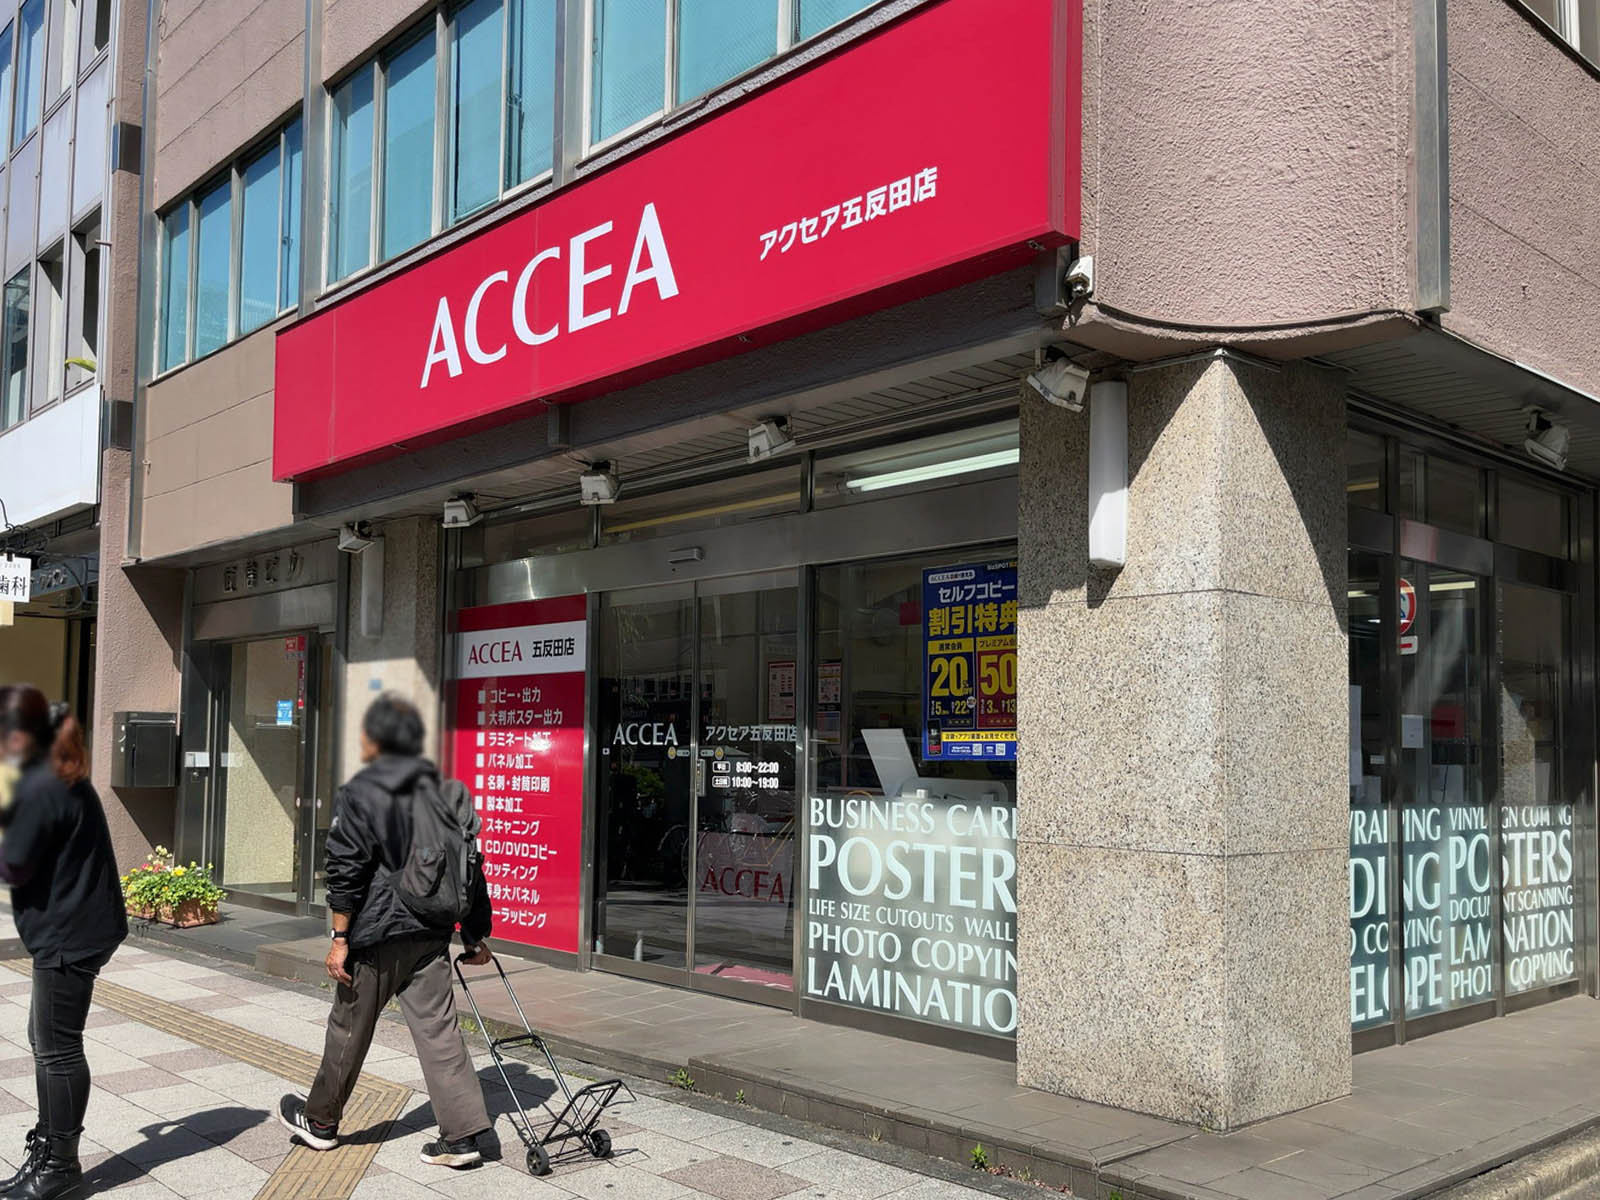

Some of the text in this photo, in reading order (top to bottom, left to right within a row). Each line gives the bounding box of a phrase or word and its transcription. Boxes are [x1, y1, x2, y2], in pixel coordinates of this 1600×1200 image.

[759, 166, 938, 261] アクセア五反田店
[420, 202, 680, 389] ACCEA
[938, 580, 1015, 603] セルフコピー
[928, 600, 1017, 636] 割引特典
[468, 638, 575, 665] ACCEA 五反田店
[931, 656, 968, 697] 20
[980, 653, 1017, 695] 50
[490, 687, 541, 704] コピー・出力
[488, 708, 563, 726] 大判ポスター出力
[613, 723, 679, 746] ACCEA
[706, 725, 797, 742] アクセア五反田店
[487, 753, 534, 770] パネル加工
[487, 775, 550, 793] 名刺・封筒印刷
[485, 818, 540, 836] スキャニング
[809, 797, 1017, 840] BUSINESS CAR
[1449, 806, 1488, 831] VINYL
[485, 840, 557, 860] CD/DVDコピー
[484, 861, 538, 881] カッティング
[701, 865, 785, 903] ACCEA
[809, 834, 1017, 914] POSTER
[809, 898, 1014, 942] LIFE SIZE CUTOUTS WALL
[808, 921, 902, 963] PHOTO
[1509, 947, 1574, 987] COPYING
[807, 956, 1017, 1033] LAMINATIO
